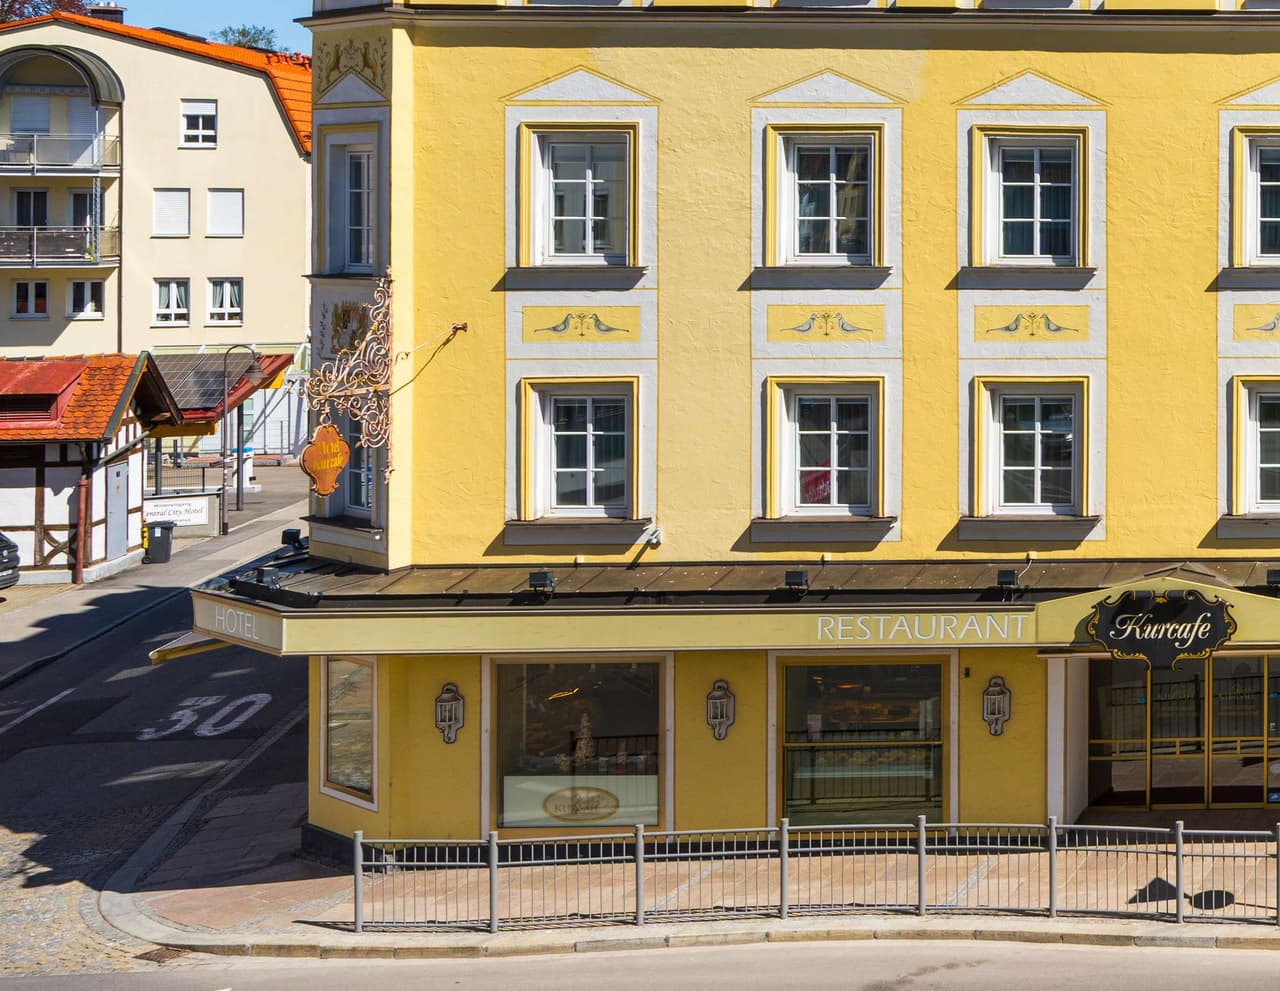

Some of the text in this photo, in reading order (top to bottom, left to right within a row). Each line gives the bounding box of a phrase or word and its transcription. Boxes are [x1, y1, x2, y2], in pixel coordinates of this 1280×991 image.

[146, 509, 166, 517] entral
[215, 606, 259, 640] HOTEL
[816, 615, 1029, 641] RESTAURANT
[1109, 612, 1212, 649] Kurcafe
[136, 693, 273, 741] 30
